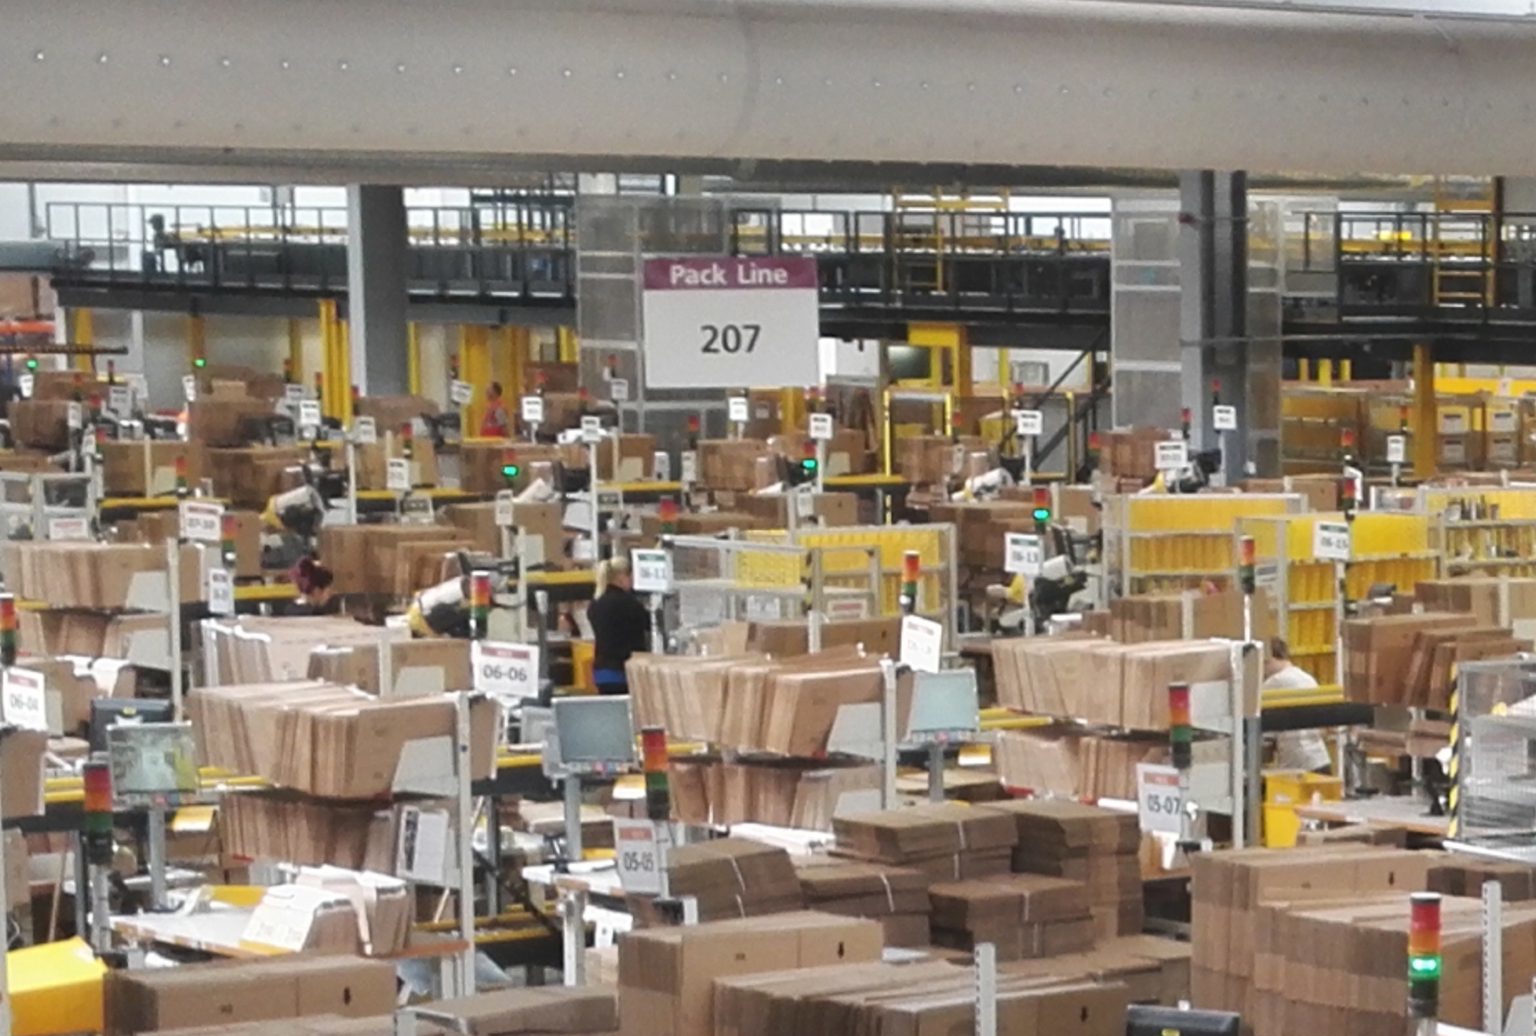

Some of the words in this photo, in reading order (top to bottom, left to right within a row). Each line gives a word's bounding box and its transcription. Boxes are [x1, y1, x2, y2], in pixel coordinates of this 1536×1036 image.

[669, 264, 726, 286] Pack
[737, 264, 788, 285] Line
[701, 324, 761, 354] 207
[483, 664, 528, 682] 06-06
[1147, 793, 1181, 816] 05-07
